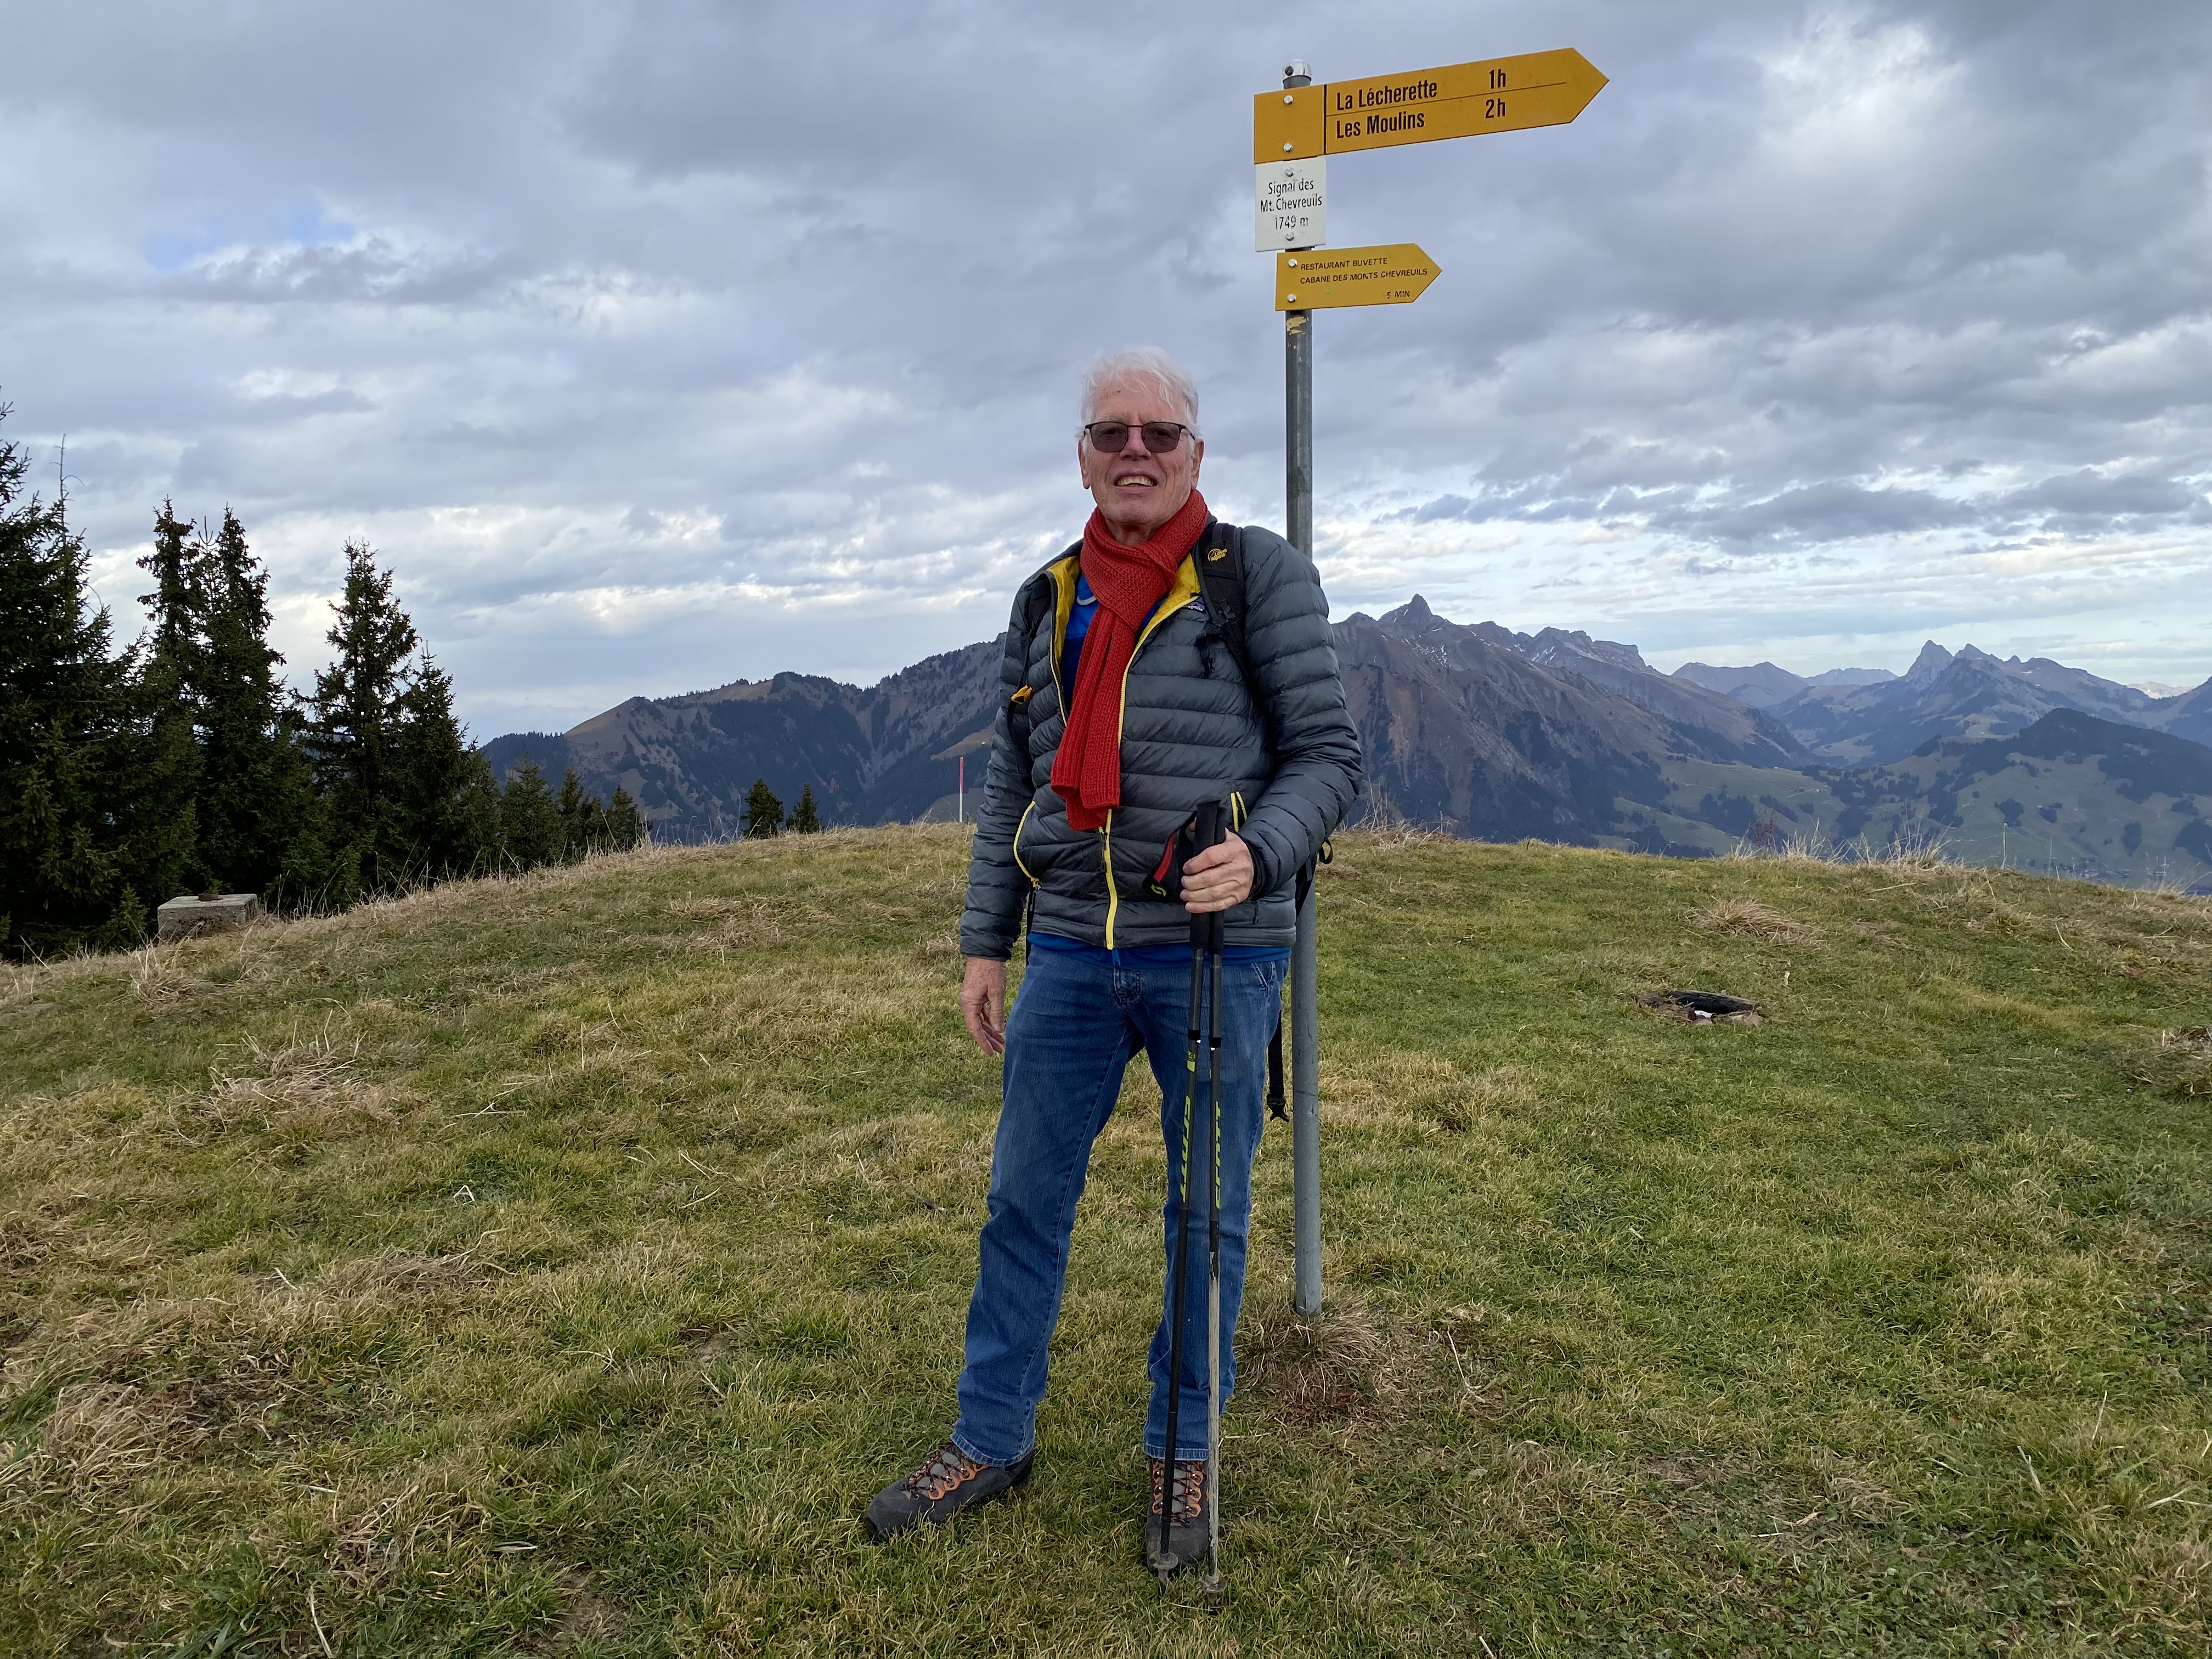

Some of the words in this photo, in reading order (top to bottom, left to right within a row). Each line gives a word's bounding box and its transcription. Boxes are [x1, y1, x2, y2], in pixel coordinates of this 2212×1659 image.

[1336, 92, 1353, 111] La
[1358, 80, 1437, 108] Lécherette
[1488, 69, 1506, 89] 1h
[1336, 120, 1361, 139] Les
[1367, 111, 1425, 134] Moulins
[1485, 98, 1505, 119] 2h
[1268, 179, 1295, 198] Signal
[1298, 177, 1314, 191] des
[1260, 199, 1274, 213] Mt.
[1276, 193, 1322, 211] Chevreuils
[1274, 215, 1296, 230] 1749
[1300, 217, 1308, 227] m
[1301, 260, 1351, 270] RESTAURANT
[1353, 257, 1388, 267] BUVETTE
[1300, 275, 1331, 284] CABANE
[1333, 274, 1348, 282] DES
[1350, 272, 1378, 281] MONTS
[1380, 268, 1427, 278] CHEVREUILS
